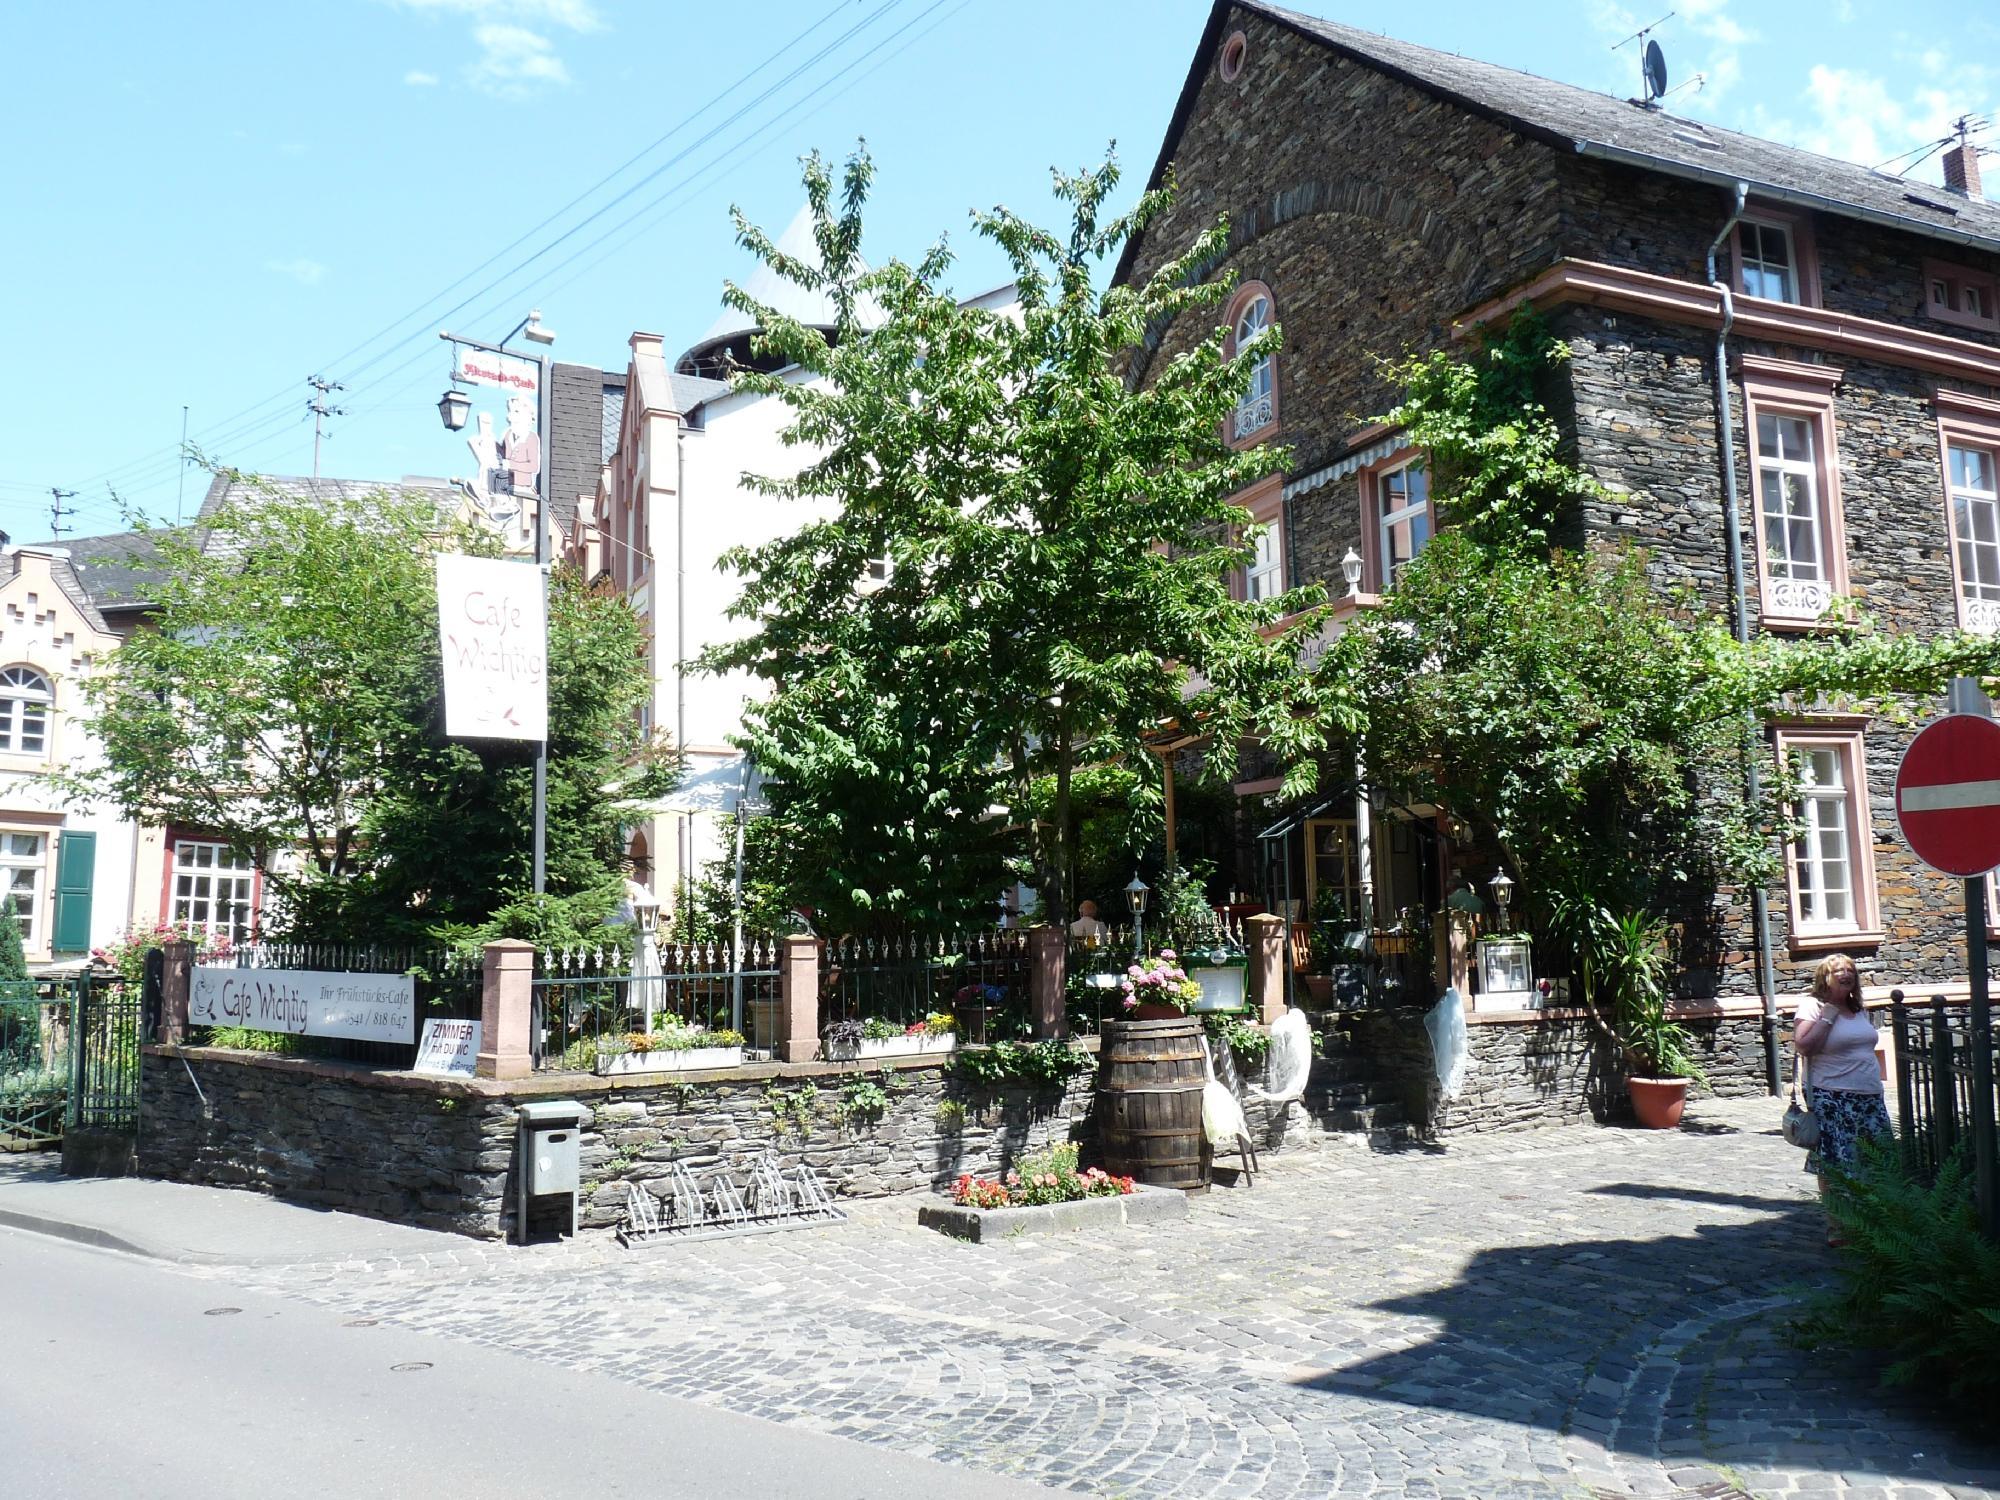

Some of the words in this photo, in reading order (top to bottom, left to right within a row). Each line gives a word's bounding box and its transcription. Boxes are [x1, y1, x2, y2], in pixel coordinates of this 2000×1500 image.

[464, 591, 521, 637] Cafe
[222, 978, 252, 1026] Cafe
[256, 981, 308, 1034] Wichtig
[320, 984, 335, 1000] Ihr
[432, 1023, 474, 1041] ZIMMER
